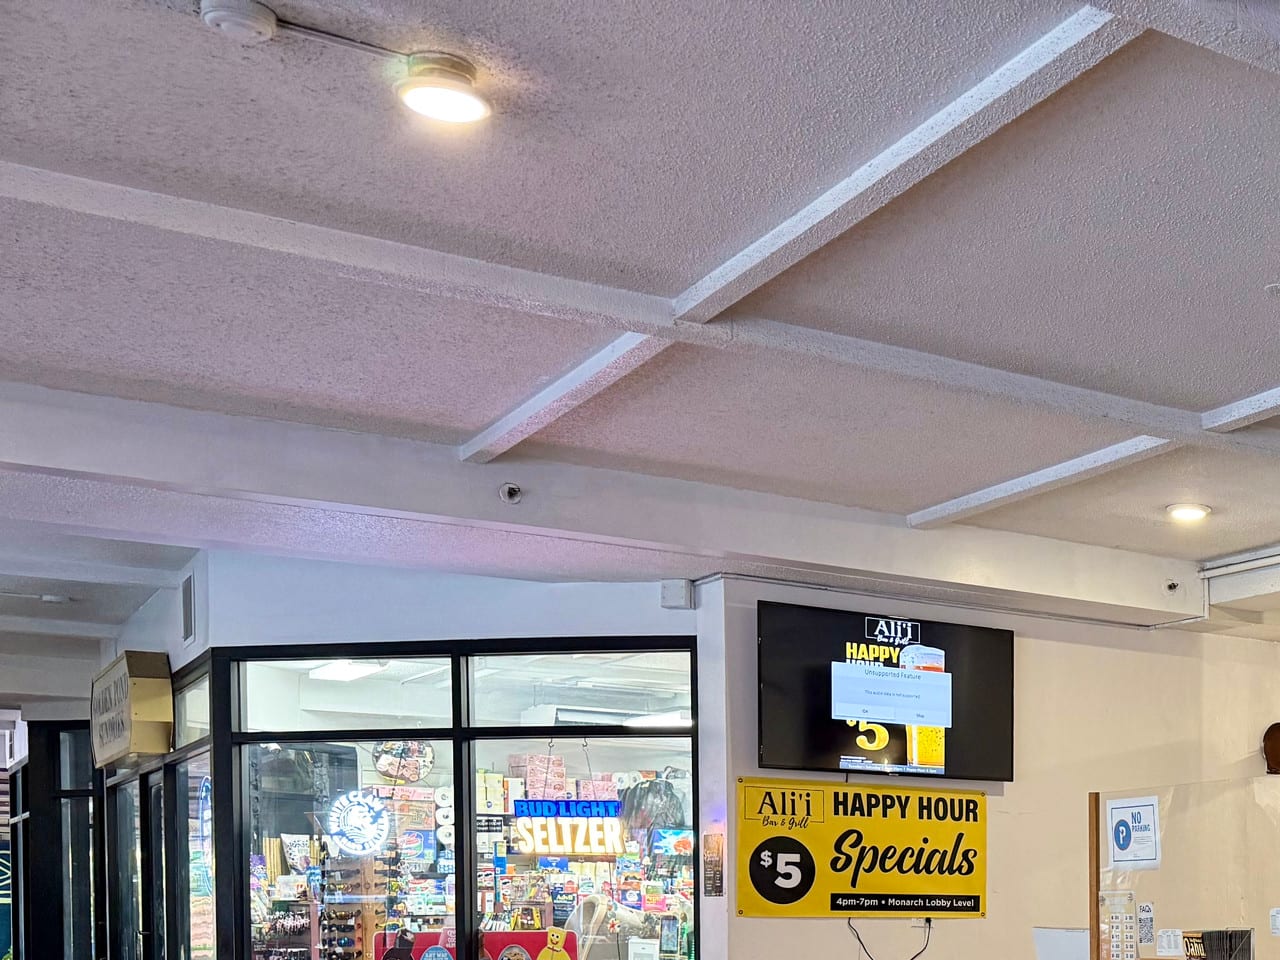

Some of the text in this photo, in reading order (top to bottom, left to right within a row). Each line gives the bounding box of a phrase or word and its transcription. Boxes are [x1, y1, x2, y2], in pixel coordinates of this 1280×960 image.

[874, 620, 913, 639] Ali'i
[846, 642, 900, 664] HAPPY
[514, 801, 619, 817] BUD LIGHT
[757, 791, 812, 817] Ali'i
[833, 791, 978, 822] HAPPY HOUR
[762, 815, 779, 826] Bar
[788, 816, 809, 830] Grill
[1131, 811, 1142, 825] NO
[1132, 824, 1151, 832] PARKING
[516, 816, 624, 854] SELTZER
[830, 829, 977, 888] Specials
[760, 850, 802, 889] $5
[836, 897, 974, 908] 4pm-7pm Monarch Lobby Level
